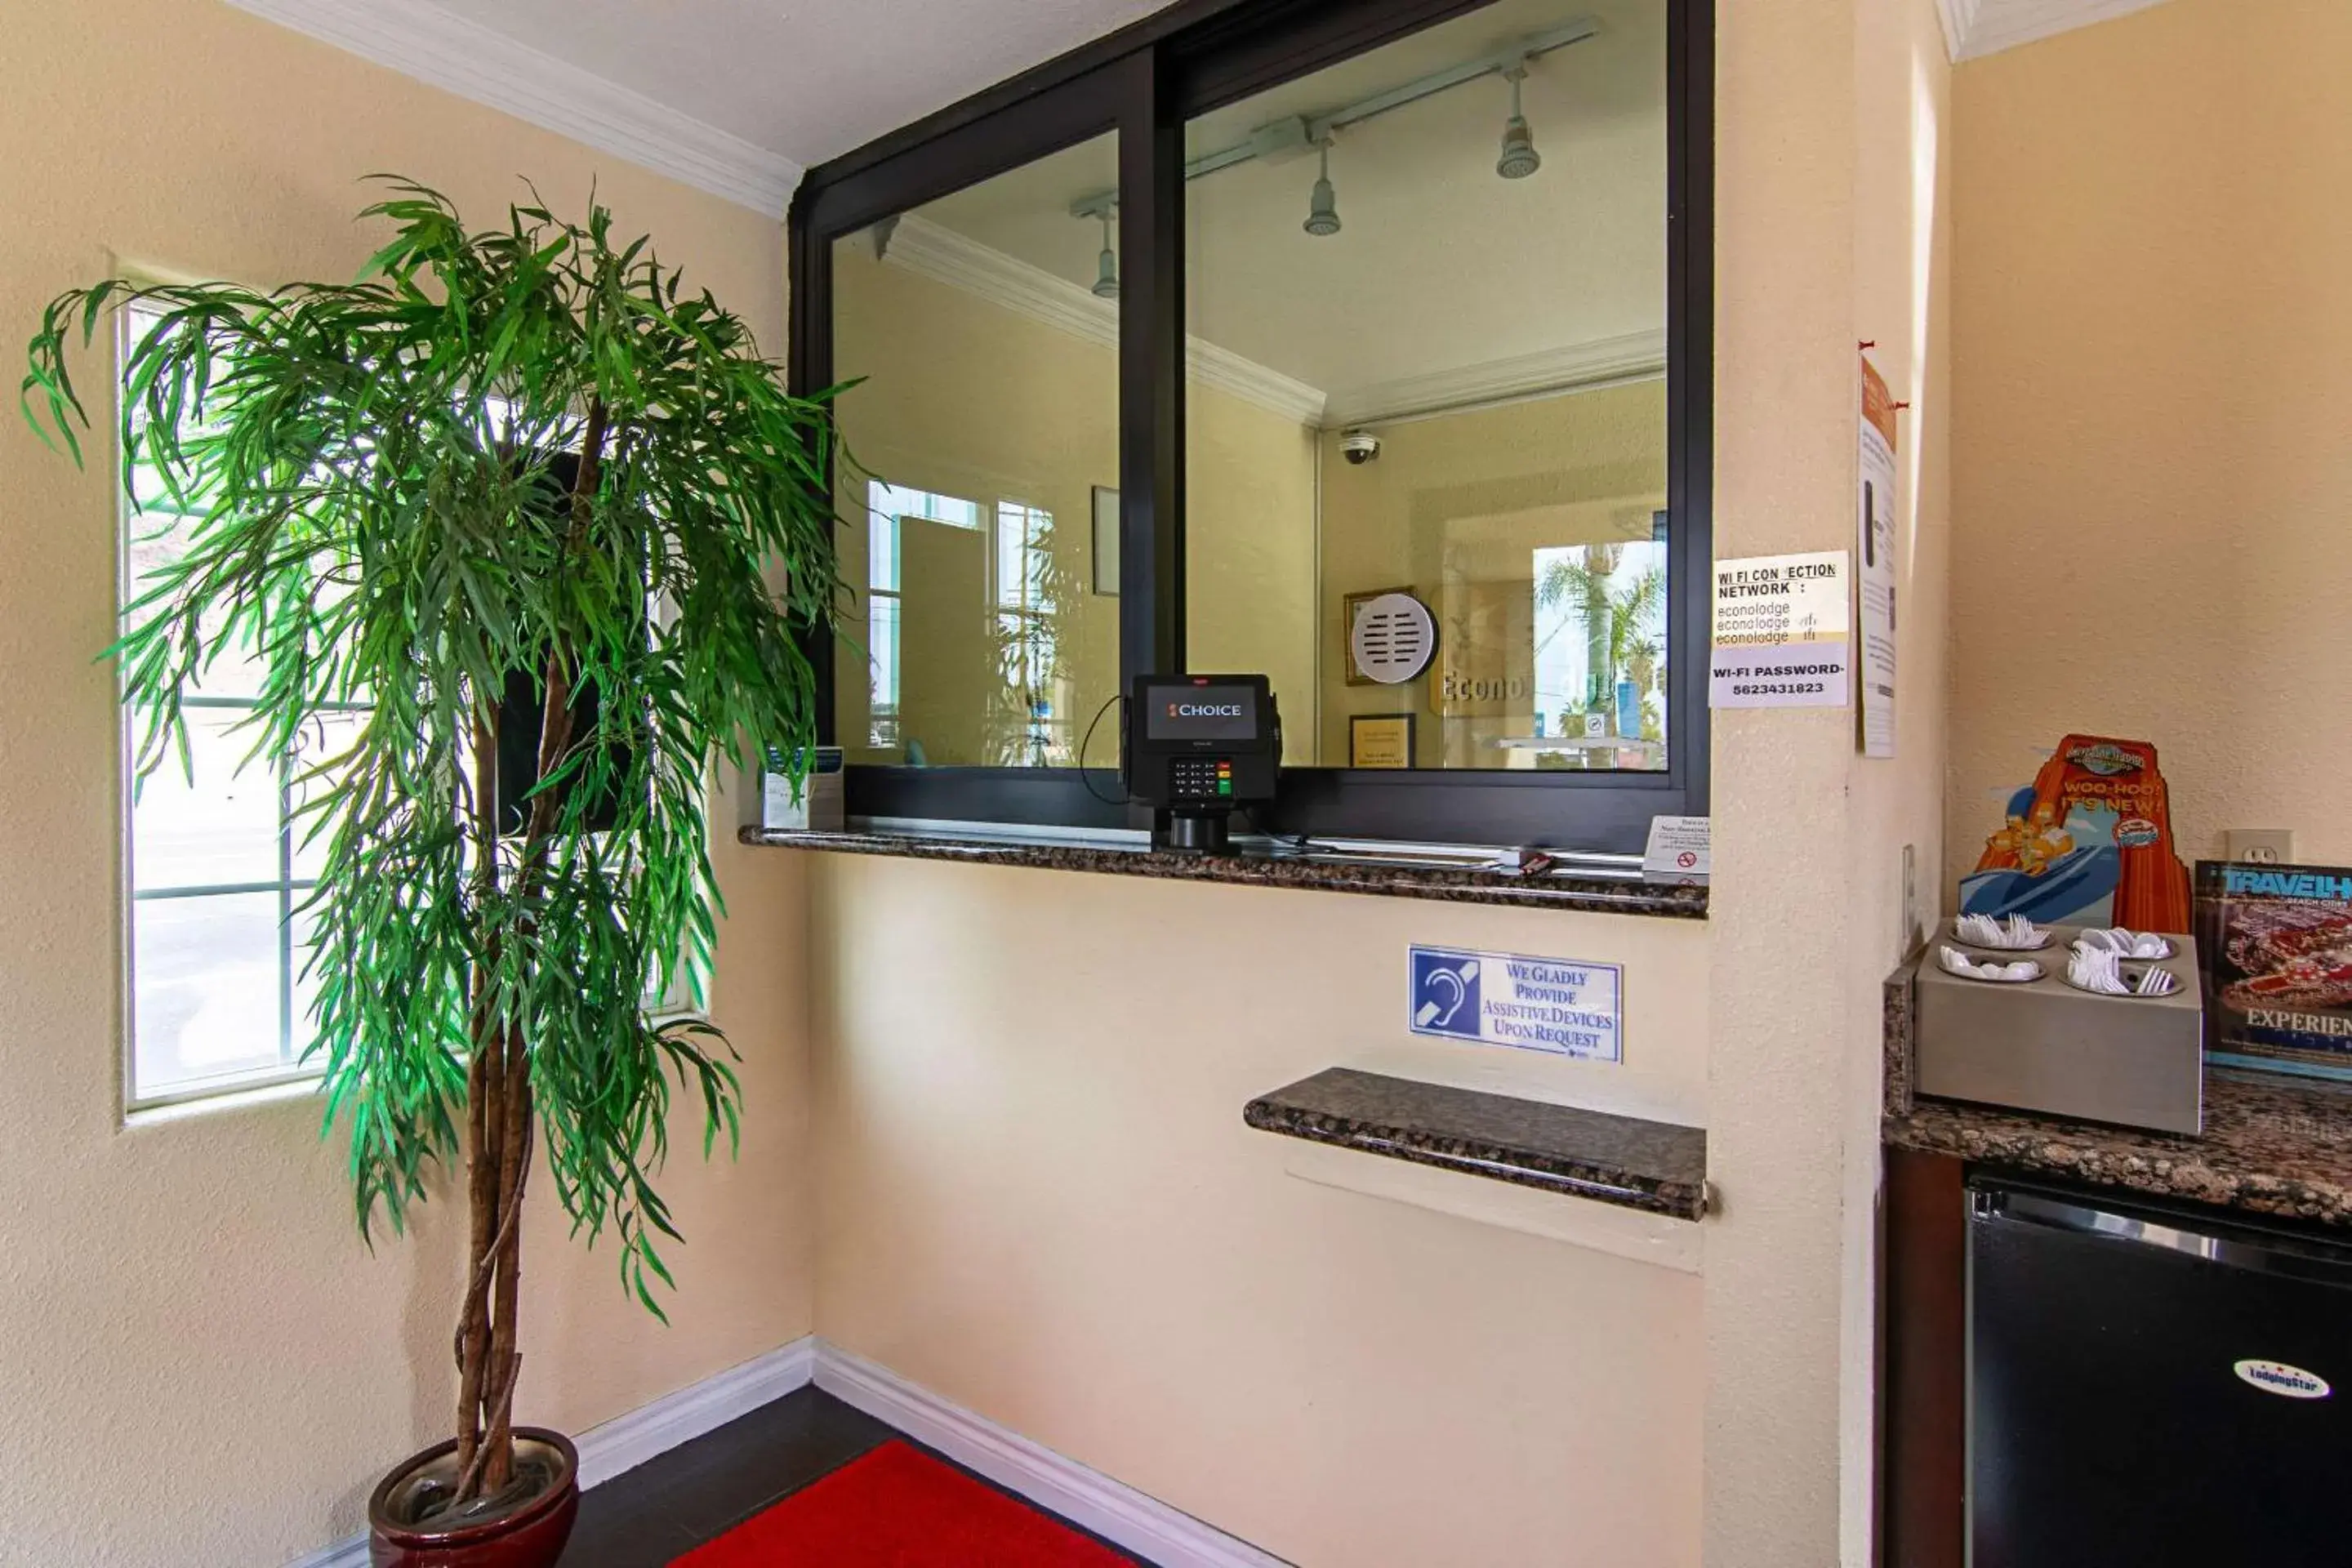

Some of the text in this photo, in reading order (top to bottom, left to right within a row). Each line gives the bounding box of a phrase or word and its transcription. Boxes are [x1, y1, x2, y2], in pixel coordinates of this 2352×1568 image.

[1718, 573, 1732, 584] WI
[1737, 572, 1748, 582] FI
[1718, 582, 1790, 599] NETWORK
[1718, 602, 1790, 617] econolodge
[1717, 617, 1790, 631] econolodge
[1716, 630, 1788, 645] econolodge
[1713, 667, 1749, 678] WI-FI
[1733, 683, 1824, 695] 5623431823
[1178, 703, 1241, 716] CHOICE
[2224, 869, 2352, 899] TRAVELH
[1506, 964, 1588, 986] WE GLADLY
[1515, 983, 1576, 1005] PROVIDE
[1483, 1000, 1613, 1029] ASSISTIVE DEVICES
[1494, 1018, 1601, 1049] UPON REQUEST
